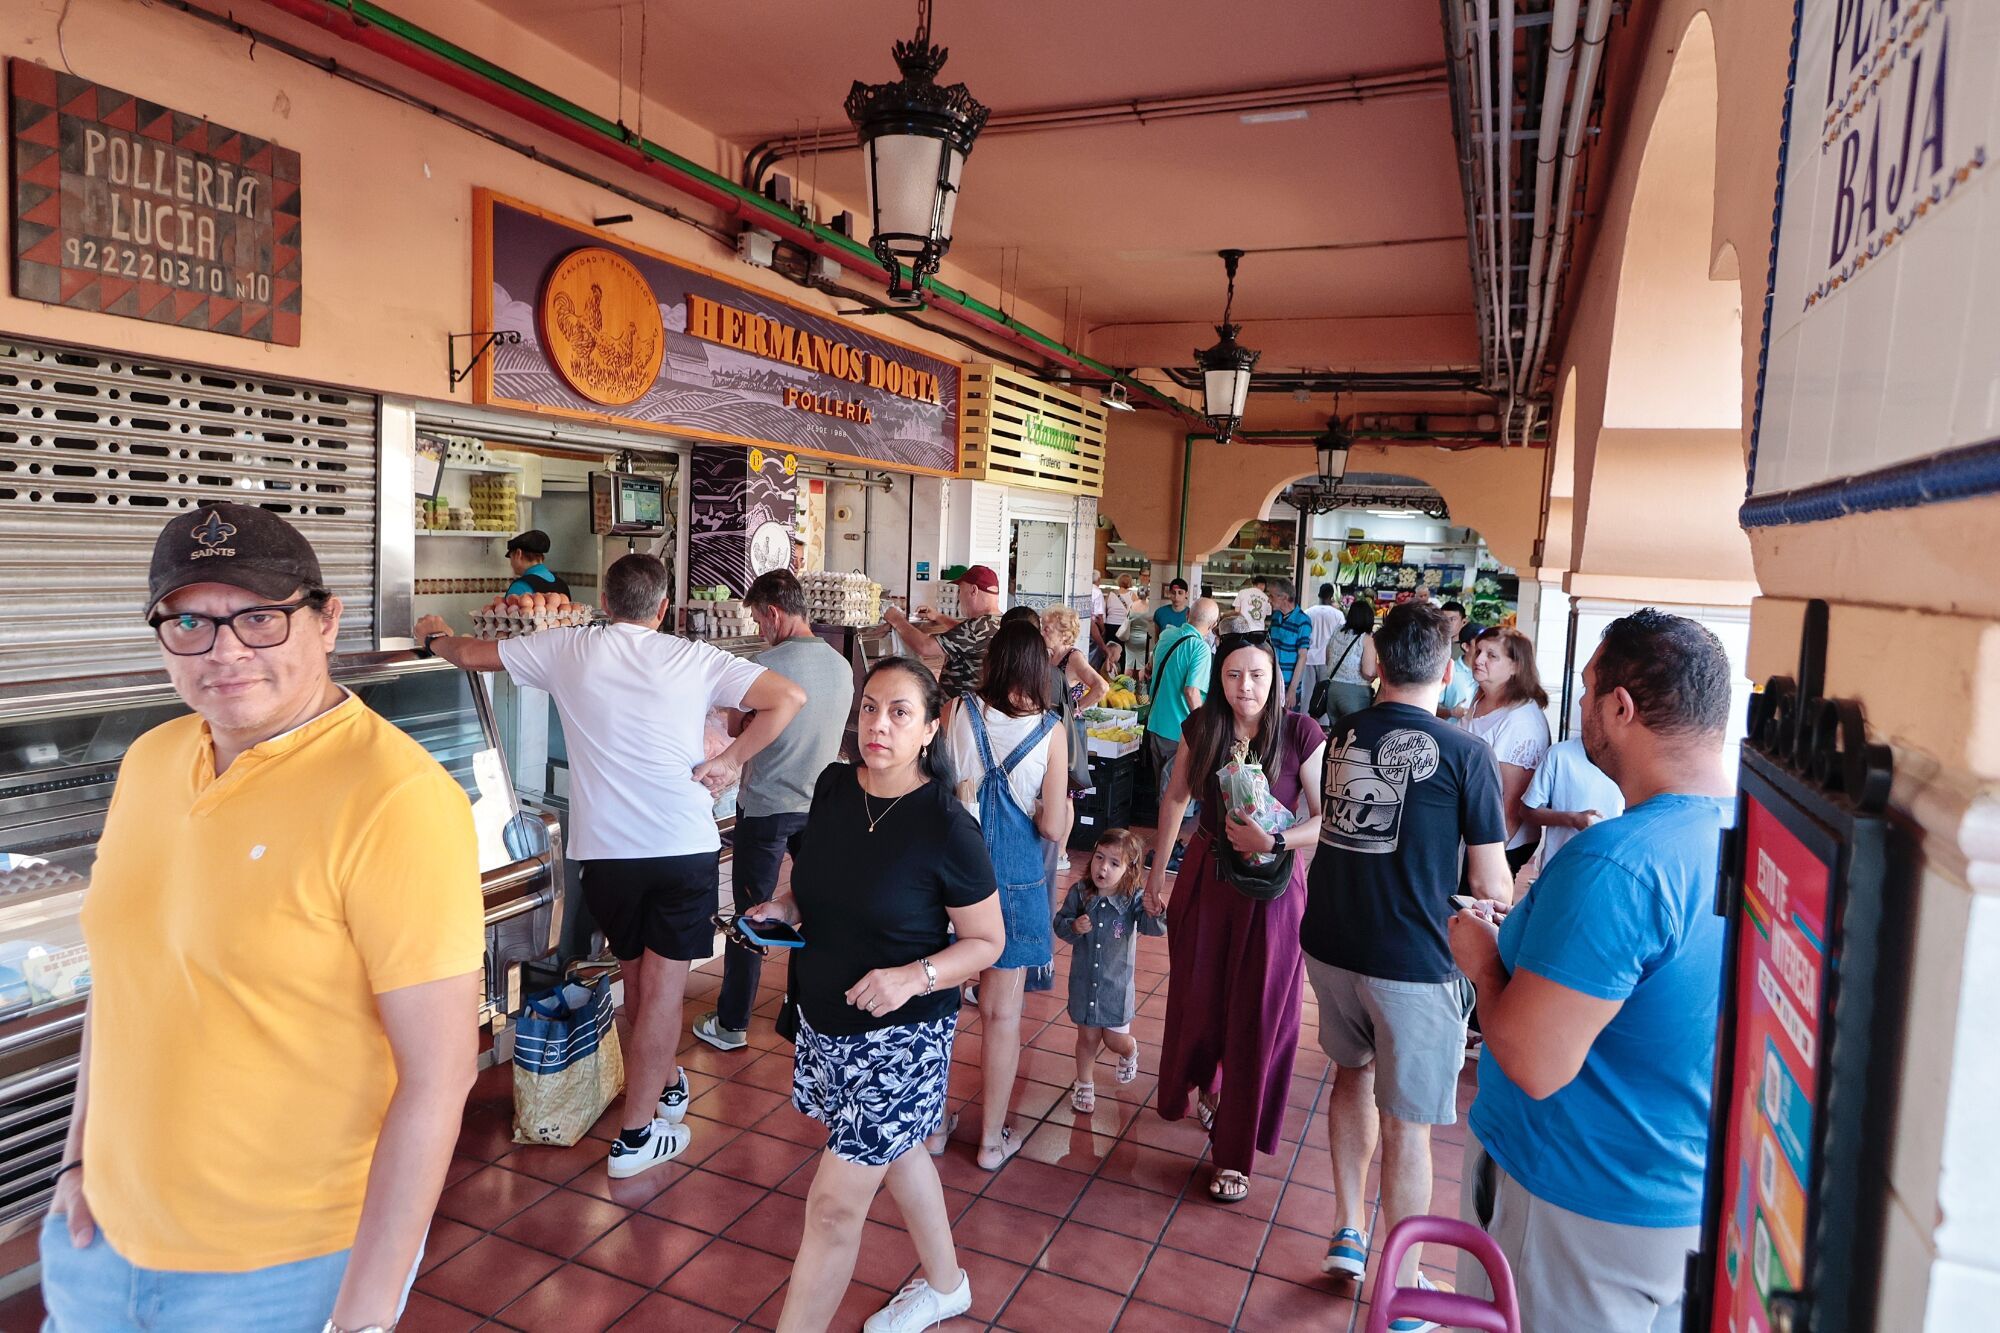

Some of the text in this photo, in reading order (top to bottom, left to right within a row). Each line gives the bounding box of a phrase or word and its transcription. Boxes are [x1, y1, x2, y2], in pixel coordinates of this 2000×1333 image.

[1829, 13, 1949, 269] BAJA
[84, 129, 260, 219] POLLERÍA
[110, 192, 215, 261] LUCÍA
[65, 237, 223, 293] 922220310
[561, 256, 597, 281] CALIDAD
[601, 256, 606, 264] Y
[684, 293, 943, 406] HERMANOS DORTA
[783, 387, 873, 425] POLLERÍA
[806, 423, 828, 434] DESDE
[190, 547, 236, 561] SAINTS
[1383, 734, 1432, 760] Healthy
[1412, 753, 1434, 775] Style
